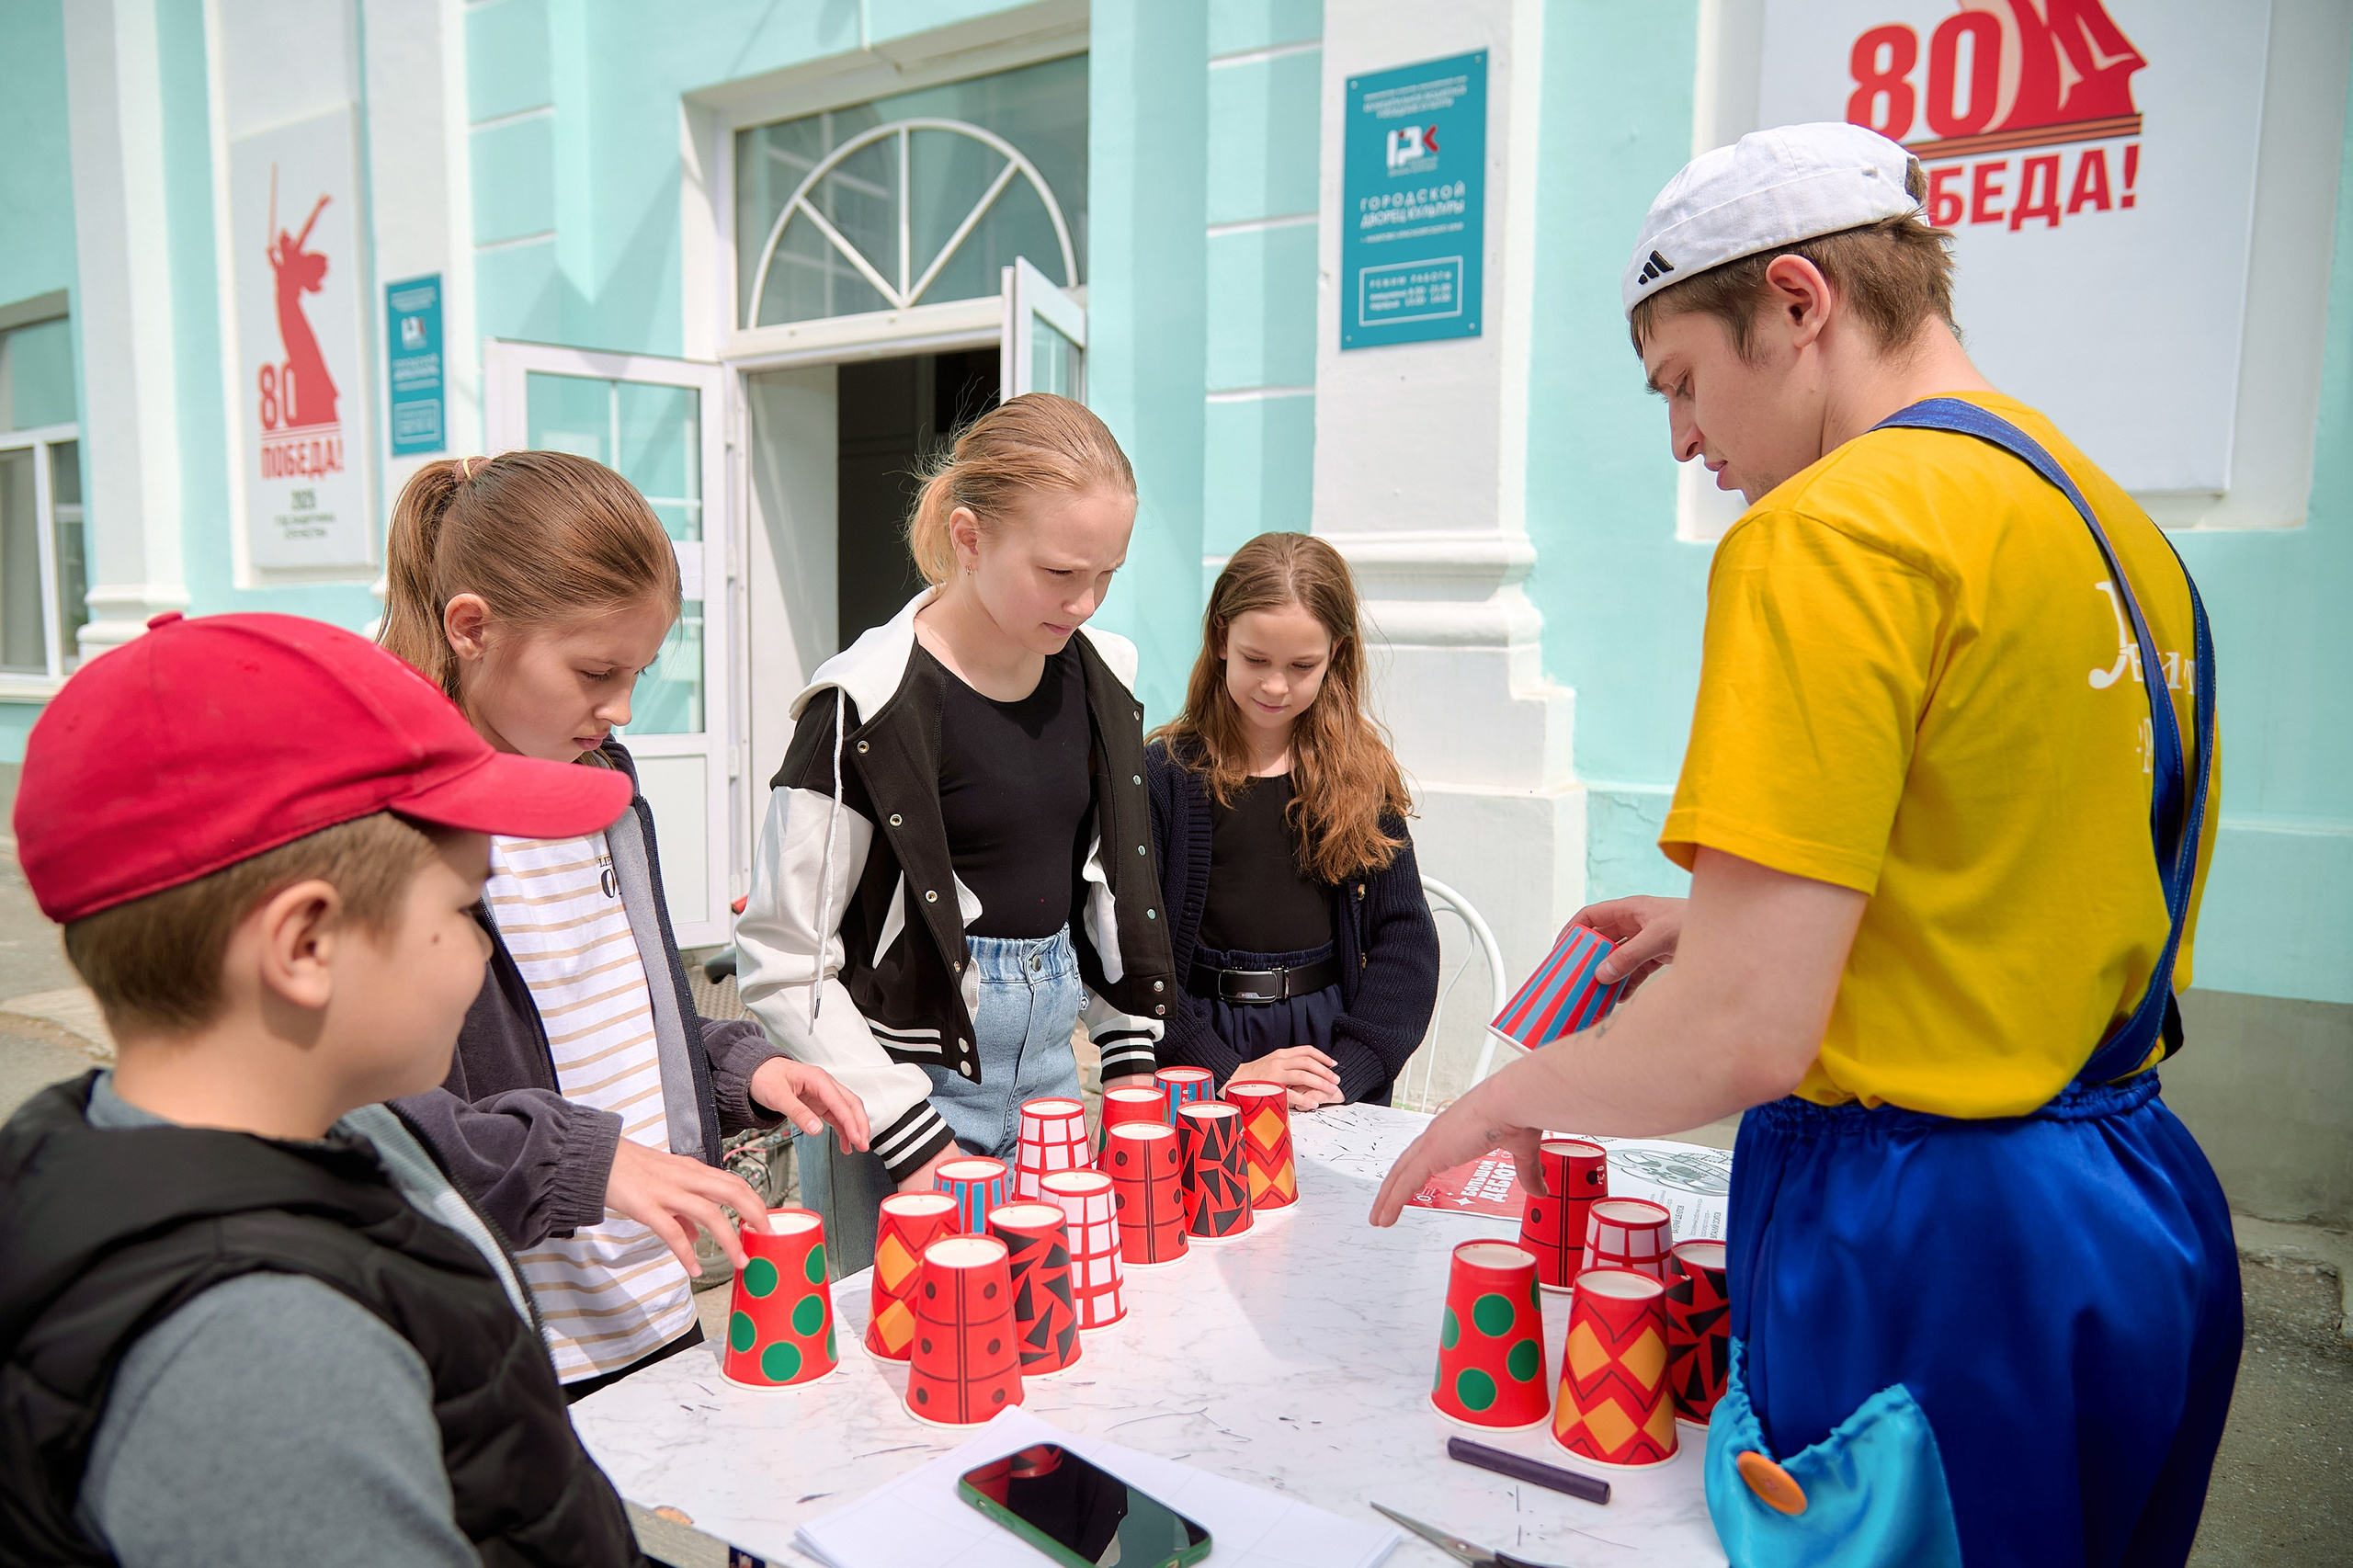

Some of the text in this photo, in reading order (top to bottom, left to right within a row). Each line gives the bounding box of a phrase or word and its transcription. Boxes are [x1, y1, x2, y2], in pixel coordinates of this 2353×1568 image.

[1847, 10, 2003, 141] 80
[1360, 180, 1466, 212] ГОРОДСКОЙ
[1928, 144, 2140, 233] БЕДА!
[260, 363, 298, 430] 80
[261, 437, 344, 480] ПОБЕДА!
[1461, 1159, 1497, 1198] БОЛЬШОЙ
[1478, 1162, 1518, 1203] ДЕБЮТ
